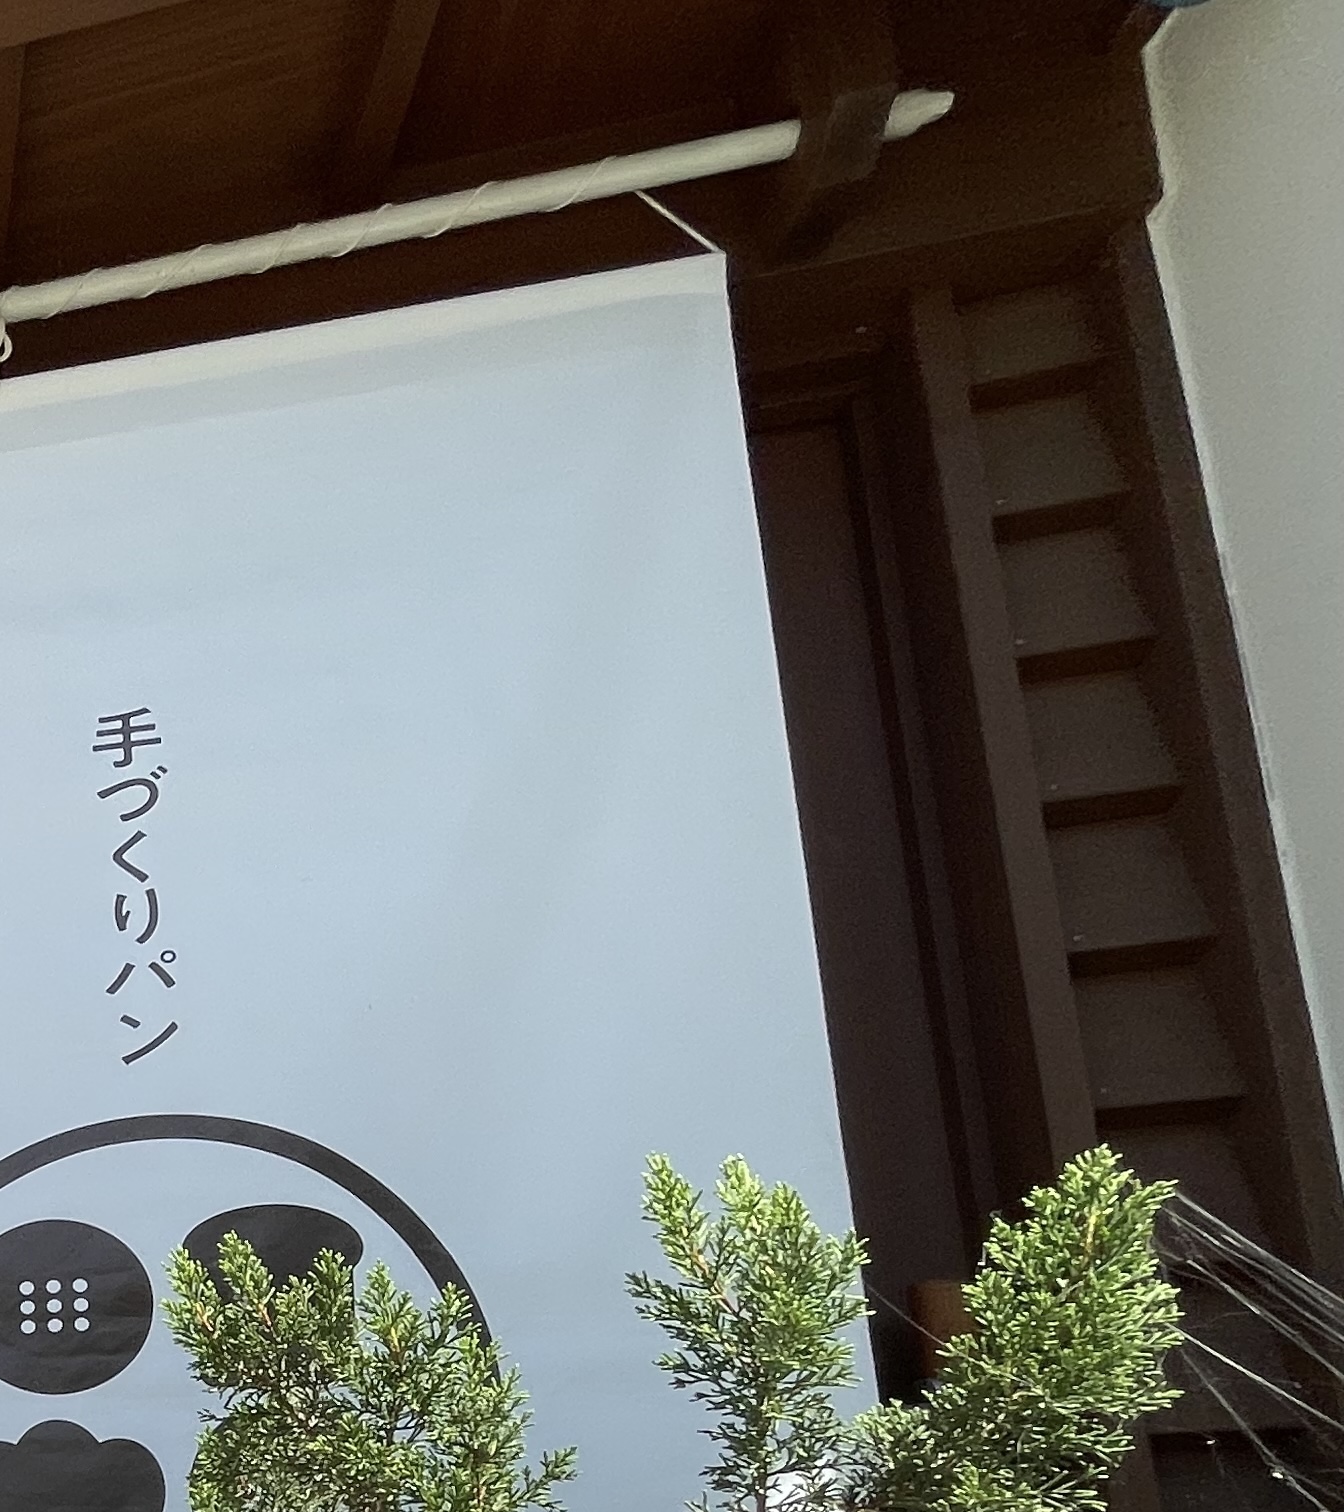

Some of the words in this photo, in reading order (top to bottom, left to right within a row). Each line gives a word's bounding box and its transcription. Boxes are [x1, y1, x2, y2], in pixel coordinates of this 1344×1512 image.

[92, 706, 180, 1066] 手づくりパン
